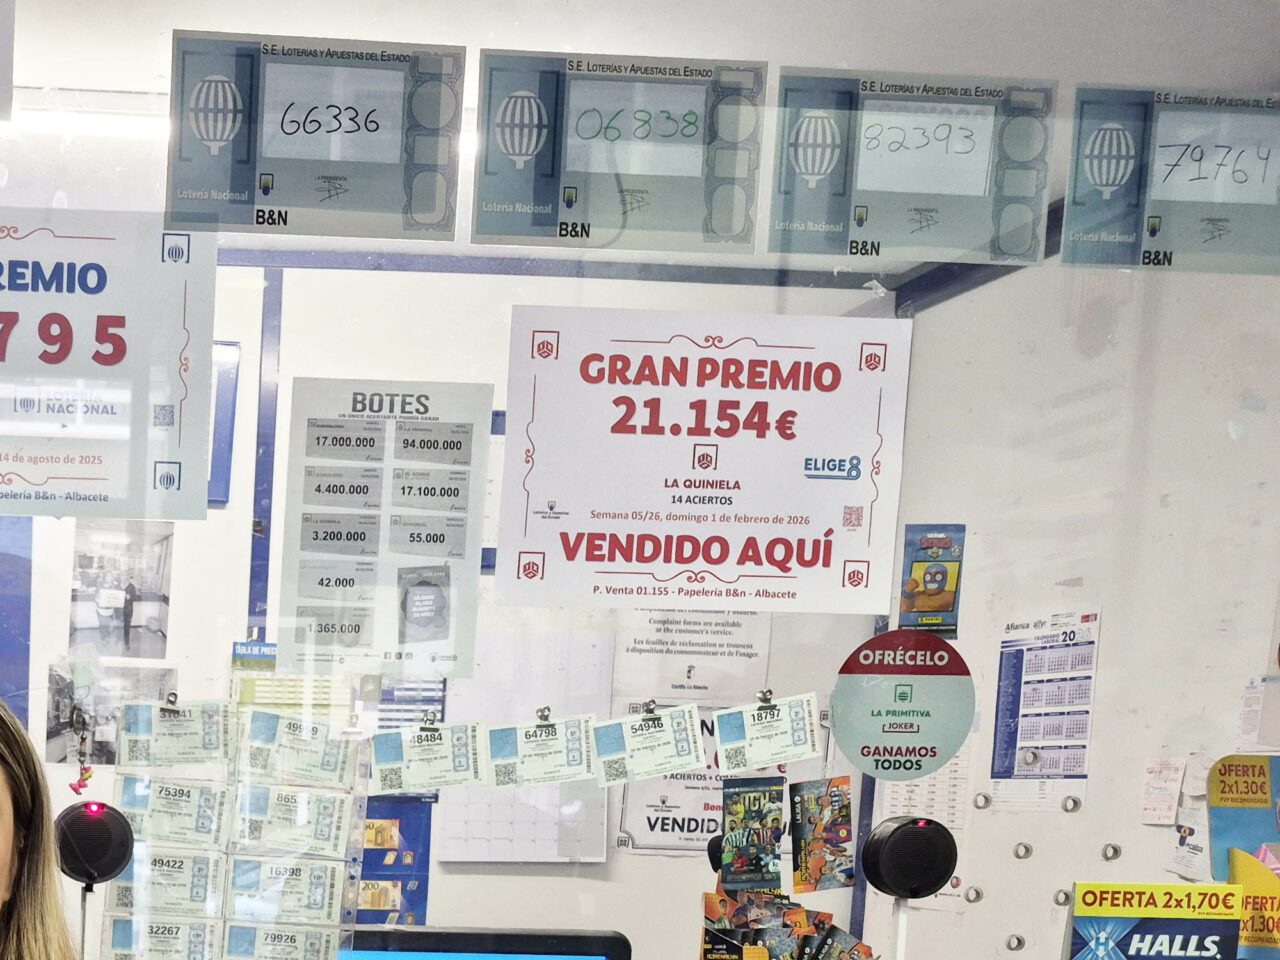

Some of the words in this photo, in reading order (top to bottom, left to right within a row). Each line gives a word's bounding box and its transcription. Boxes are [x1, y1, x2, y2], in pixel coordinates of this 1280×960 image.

[568, 61, 585, 72] S.E.
[624, 65, 628, 74] Y
[630, 64, 667, 75] APUESTAS
[669, 67, 681, 76] DEL
[683, 67, 713, 78] ESTADO
[280, 102, 380, 135] 66336
[576, 107, 699, 142] 06838
[864, 122, 976, 155] 82393
[256, 209, 288, 226] B&N
[559, 222, 590, 238] B&N
[849, 240, 881, 256] B&N
[1142, 251, 1172, 266] B&N
[579, 353, 688, 386] GRAN
[697, 358, 842, 392] PREMIO
[351, 392, 430, 415] BOTES
[610, 396, 798, 440] 21.154€
[315, 436, 375, 448] 17.000.000
[402, 439, 462, 451] 94.000.000
[315, 484, 369, 495] 4.400.000
[401, 486, 460, 498] 17.100.000
[312, 531, 366, 542] 3.200.000
[409, 533, 445, 544] 55.000
[559, 531, 729, 565] VENDIDO
[736, 528, 836, 573] AQUÍ
[318, 577, 355, 588] 42.000
[859, 646, 949, 666] OFRÉCELO
[751, 709, 781, 722] 18797
[871, 709, 884, 718] LA
[886, 709, 931, 718] PRIMITIVA
[631, 720, 664, 734] 54946
[888, 722, 914, 730] JOKER
[409, 732, 443, 744] 48484
[524, 726, 558, 740] 64798
[861, 745, 937, 758] GANAMOS
[874, 759, 923, 771] TODOS
[1219, 764, 1266, 778] OFERTA
[158, 786, 191, 799] 75394
[1220, 780, 1267, 795] 2x1.30€
[151, 858, 184, 870] 49422
[269, 866, 302, 878] 16398
[1081, 890, 1158, 908] OFERTA
[1162, 892, 1235, 913] 2x1,70€
[147, 925, 180, 937] 32267
[263, 933, 297, 945] 79926
